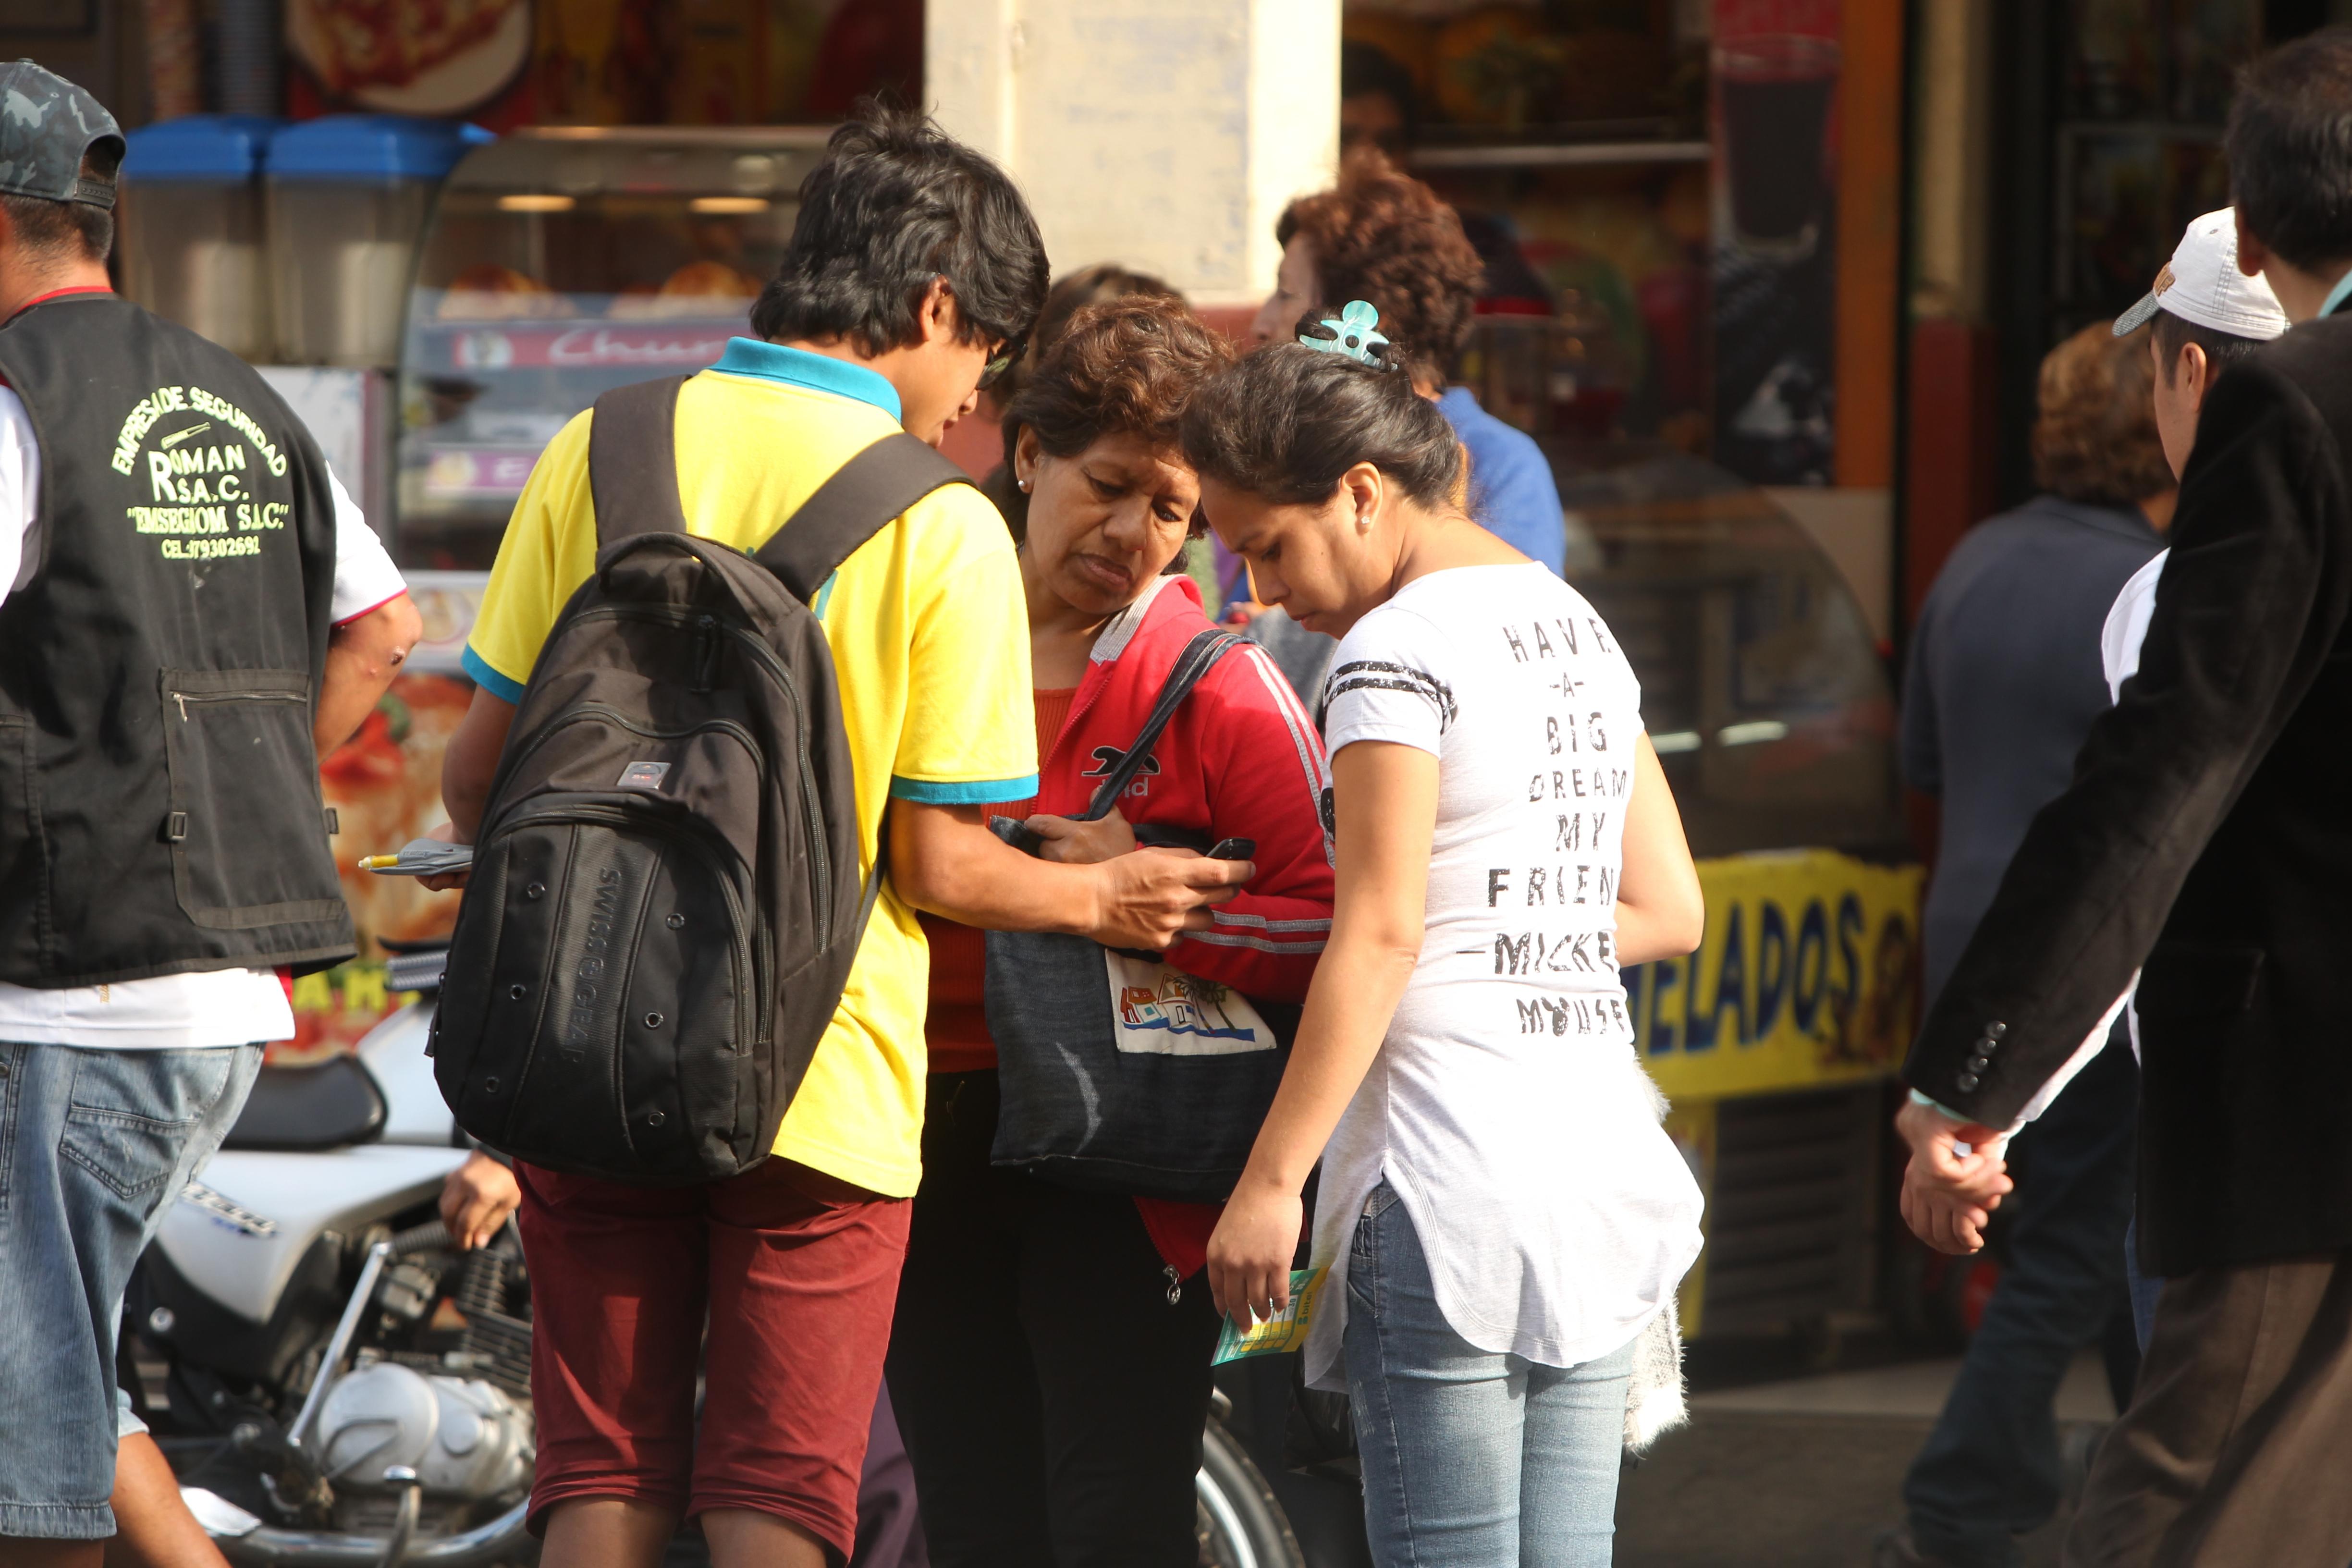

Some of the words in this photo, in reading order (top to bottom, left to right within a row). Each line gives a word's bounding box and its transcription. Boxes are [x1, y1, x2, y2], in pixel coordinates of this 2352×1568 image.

[189, 386, 287, 477] SEGURIDAD
[148, 444, 246, 502] ROMAN
[1502, 618, 1612, 662] HAVE
[1547, 711, 1607, 754] BIG
[1529, 767, 1627, 801] DREAM
[1556, 812, 1605, 851] MY
[1488, 865, 1620, 907] FRIEN
[1494, 931, 1616, 975] MICKE
[1301, 1292, 1312, 1315] bitel
